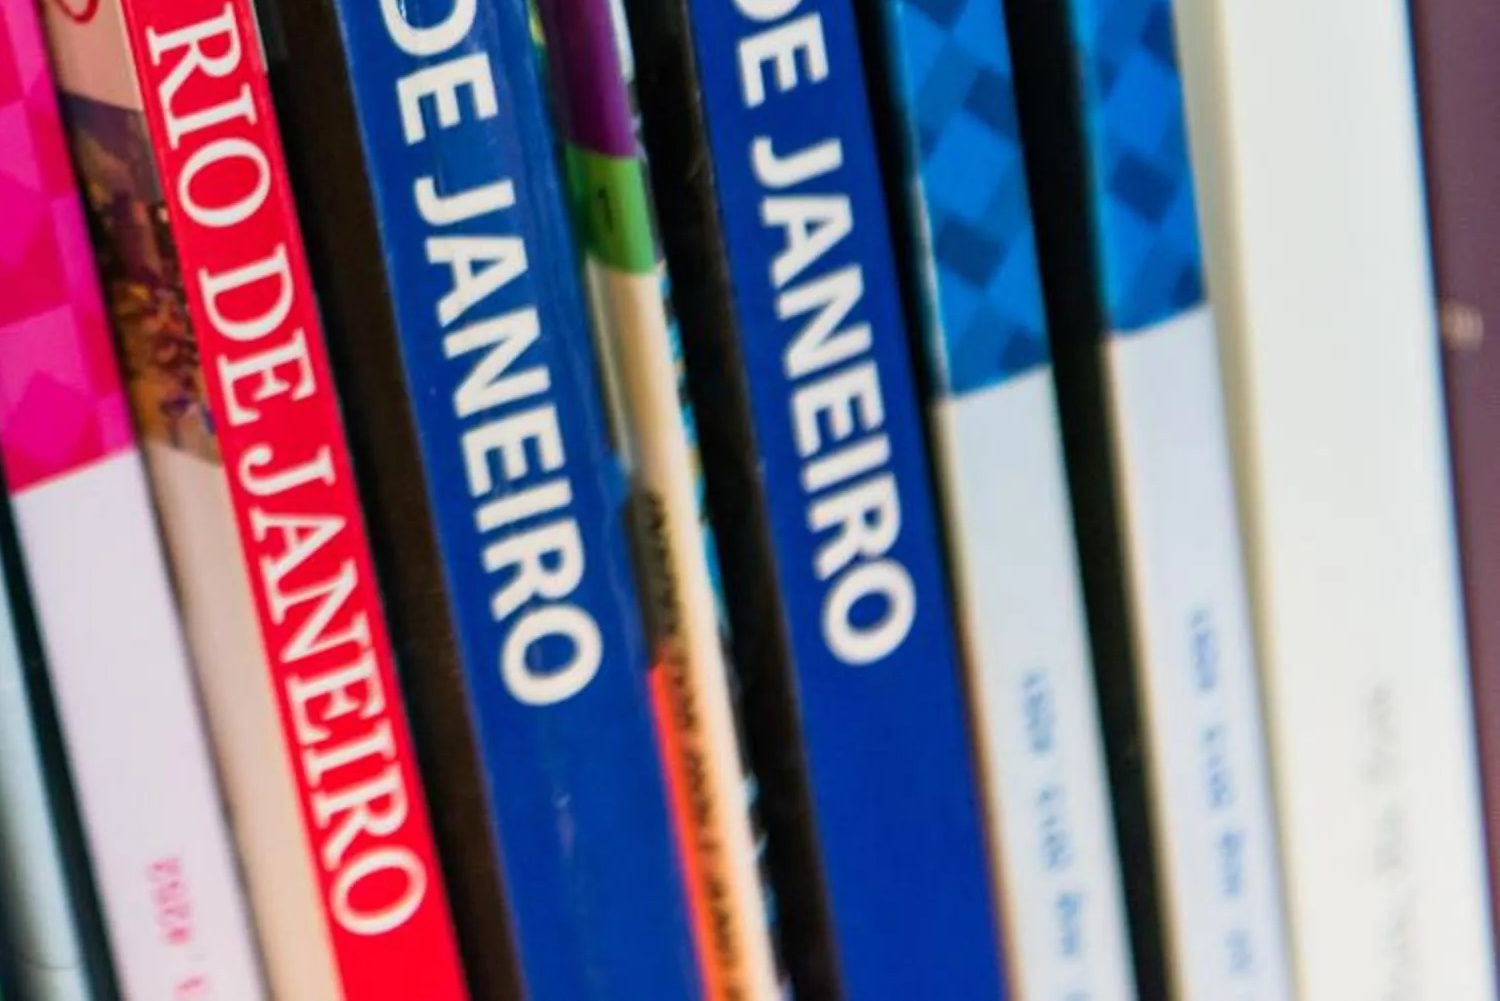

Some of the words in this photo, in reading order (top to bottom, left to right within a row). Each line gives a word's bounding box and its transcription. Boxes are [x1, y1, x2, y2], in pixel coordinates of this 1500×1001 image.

[145, 2, 272, 227] RIO
[198, 244, 316, 426] DE
[412, 177, 603, 706] JANEIRO
[751, 136, 917, 665] JANEIRO
[237, 446, 426, 935] JANEIRO
